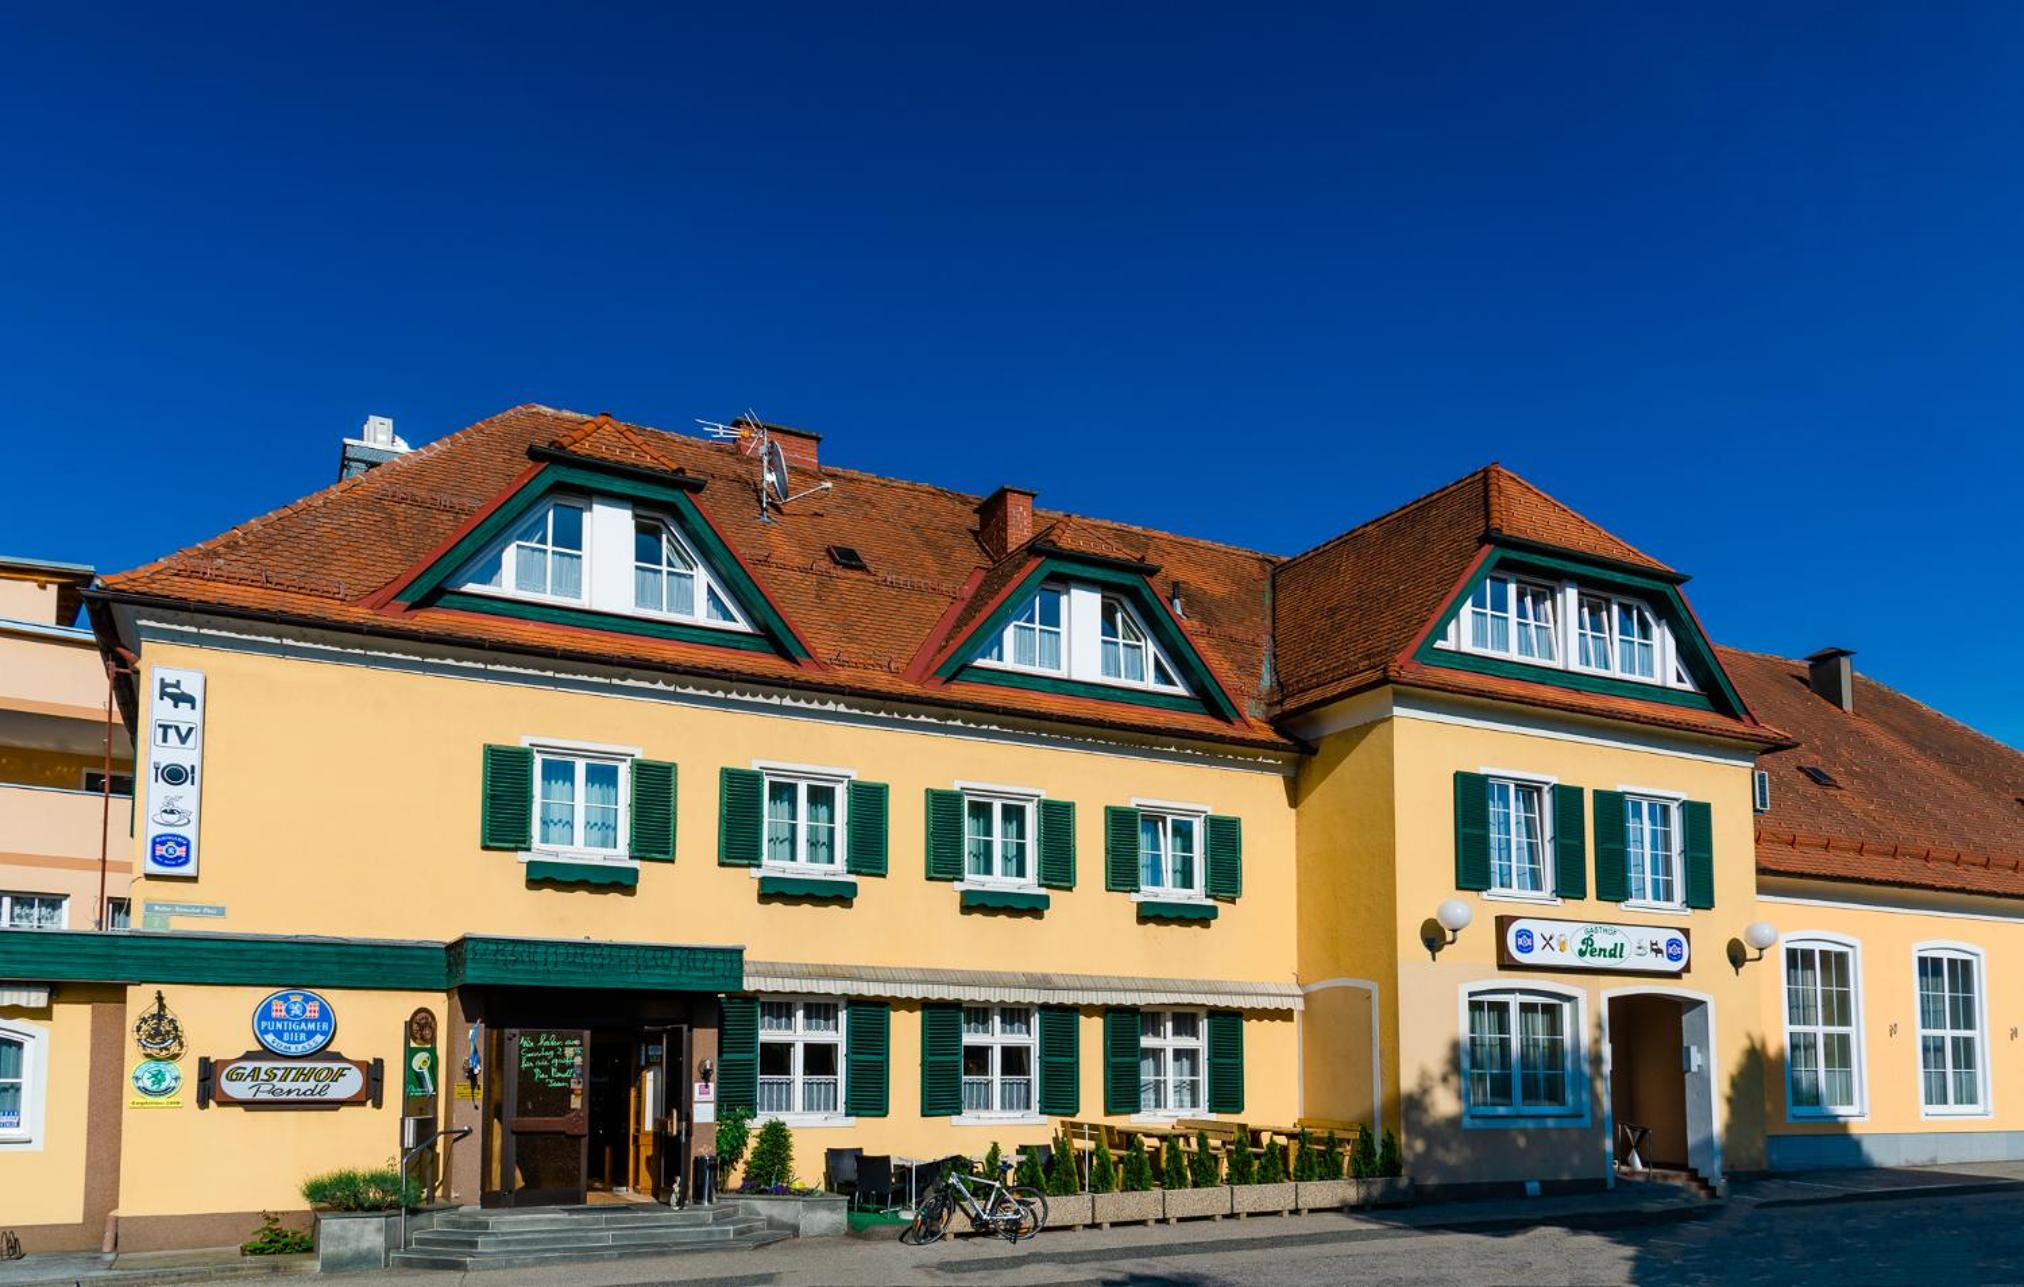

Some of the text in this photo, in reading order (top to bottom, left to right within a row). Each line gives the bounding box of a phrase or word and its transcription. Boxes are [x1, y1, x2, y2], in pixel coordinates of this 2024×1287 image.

[157, 723, 195, 746] TV
[1577, 934, 1626, 959] Pendl
[260, 1020, 329, 1032] PUNTIGAMER
[282, 1032, 307, 1042] BIER
[225, 1066, 352, 1083] GASTHOF
[248, 1082, 330, 1098] Pendl
